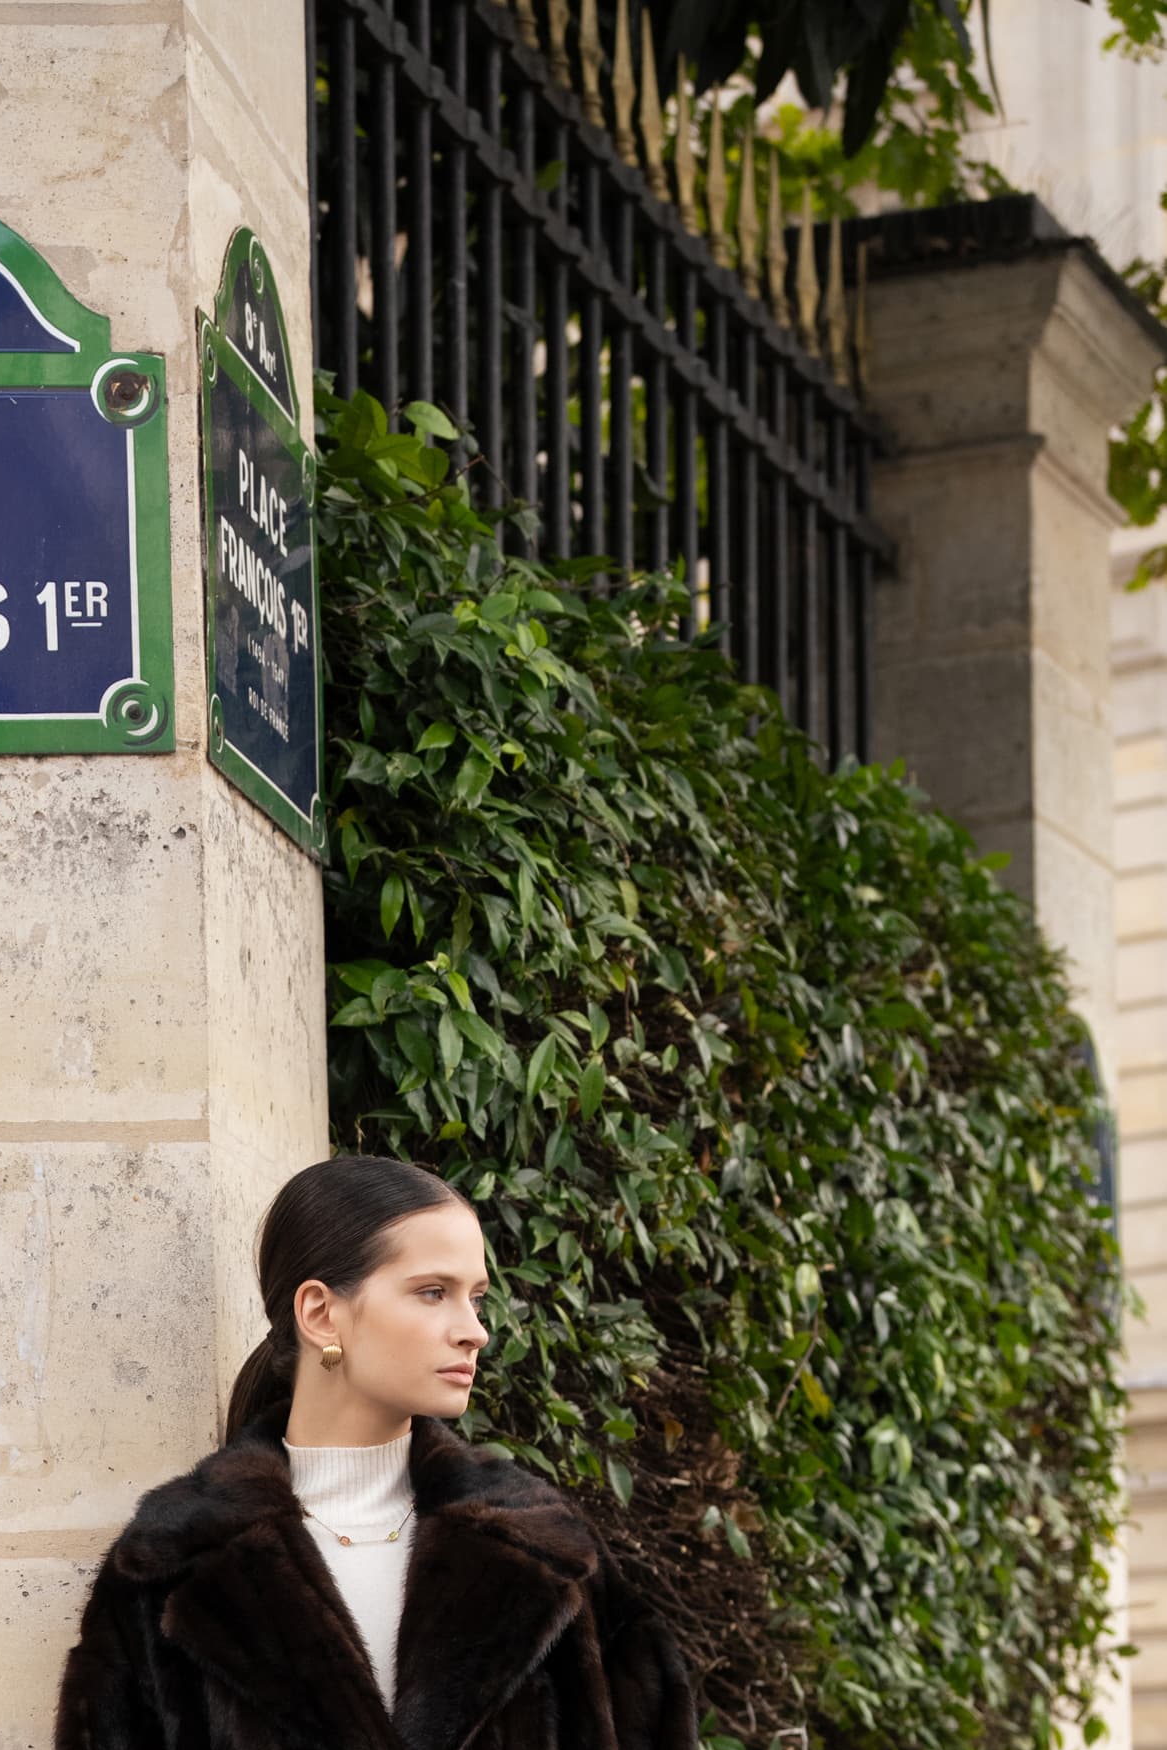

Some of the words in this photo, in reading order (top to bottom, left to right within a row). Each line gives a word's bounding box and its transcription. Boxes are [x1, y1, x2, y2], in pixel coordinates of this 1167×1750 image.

[239, 449, 288, 557] PLACE
[36, 580, 109, 652] 1ER
[220, 514, 287, 640] FRANÇOIS
[291, 599, 309, 655] 1ER
[248, 686, 259, 711] ROI
[260, 698, 268, 721] DE
